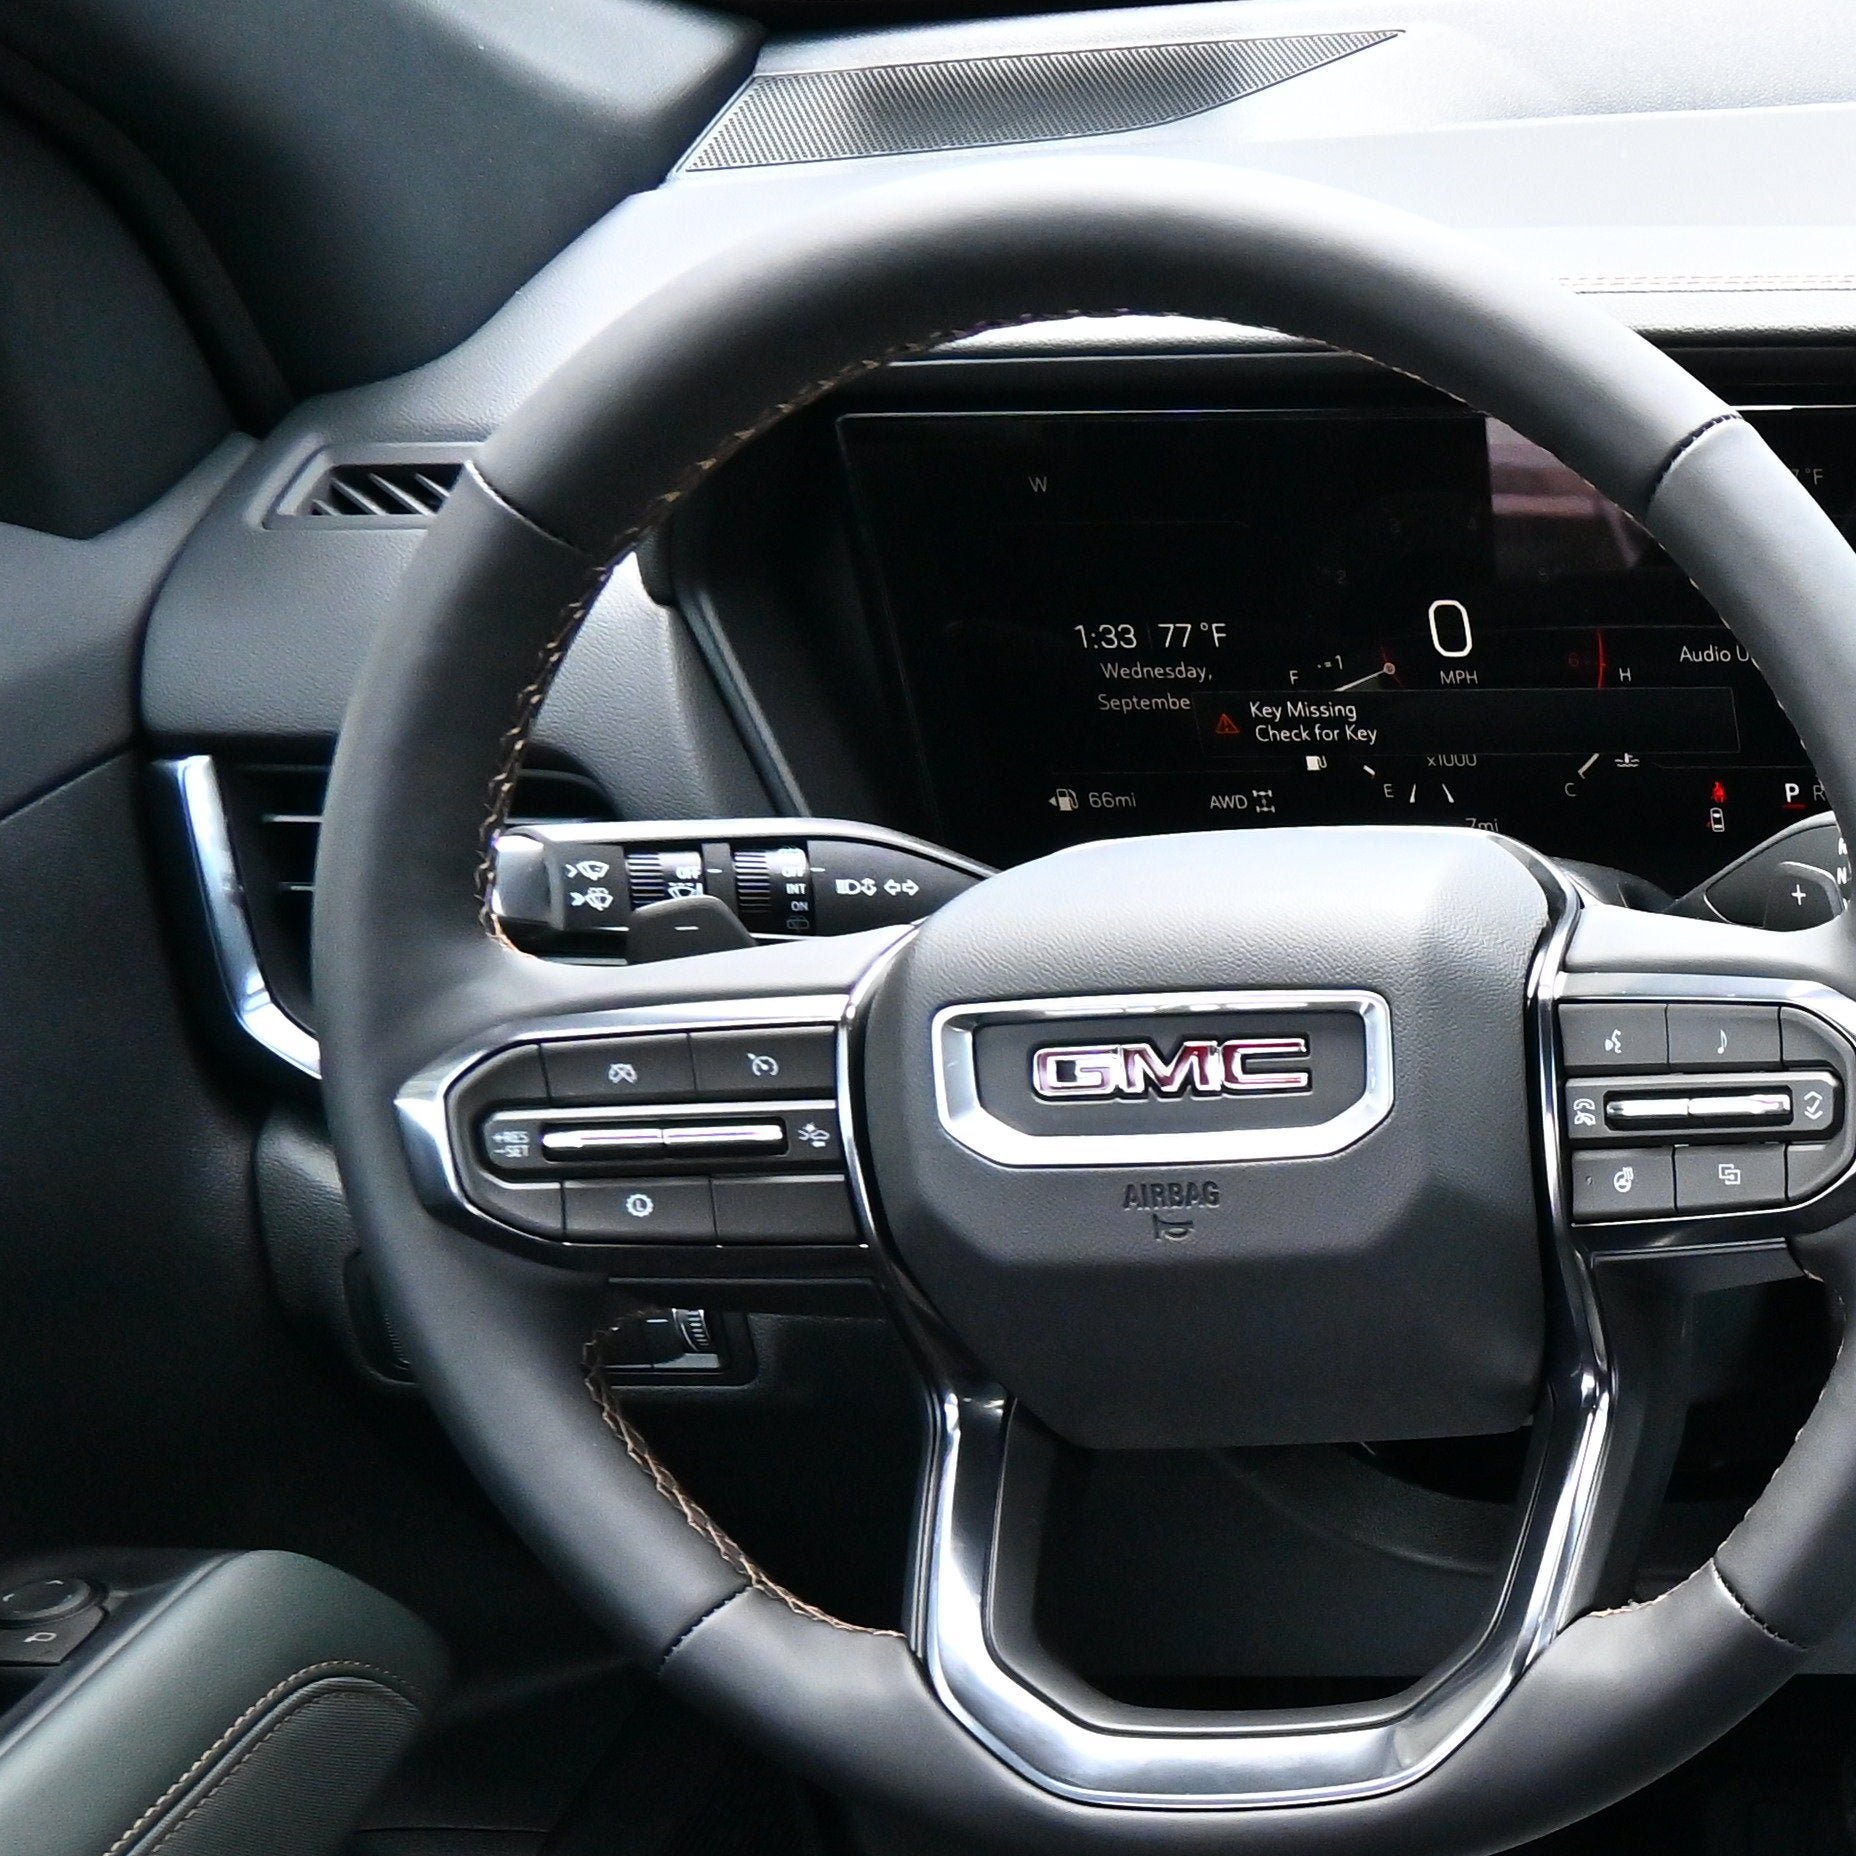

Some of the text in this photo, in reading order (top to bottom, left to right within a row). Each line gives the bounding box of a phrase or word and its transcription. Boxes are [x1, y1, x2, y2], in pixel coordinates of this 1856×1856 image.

[1074, 624, 1138, 649] 1:33
[1428, 599, 1473, 658] 0
[1680, 645, 1731, 663] Audio
[1100, 661, 1213, 683] Wednesday,
[1440, 670, 1479, 685] MPH
[1250, 701, 1357, 722] Key Missing
[1255, 723, 1378, 745] Check for Key
[1088, 791, 1138, 808] 66mi
[1209, 794, 1249, 810] AWD
[1785, 782, 1800, 803] P
[786, 882, 807, 895] INT
[1032, 1038, 1311, 1098] GMC
[1123, 1179, 1221, 1211] AIRBAG
